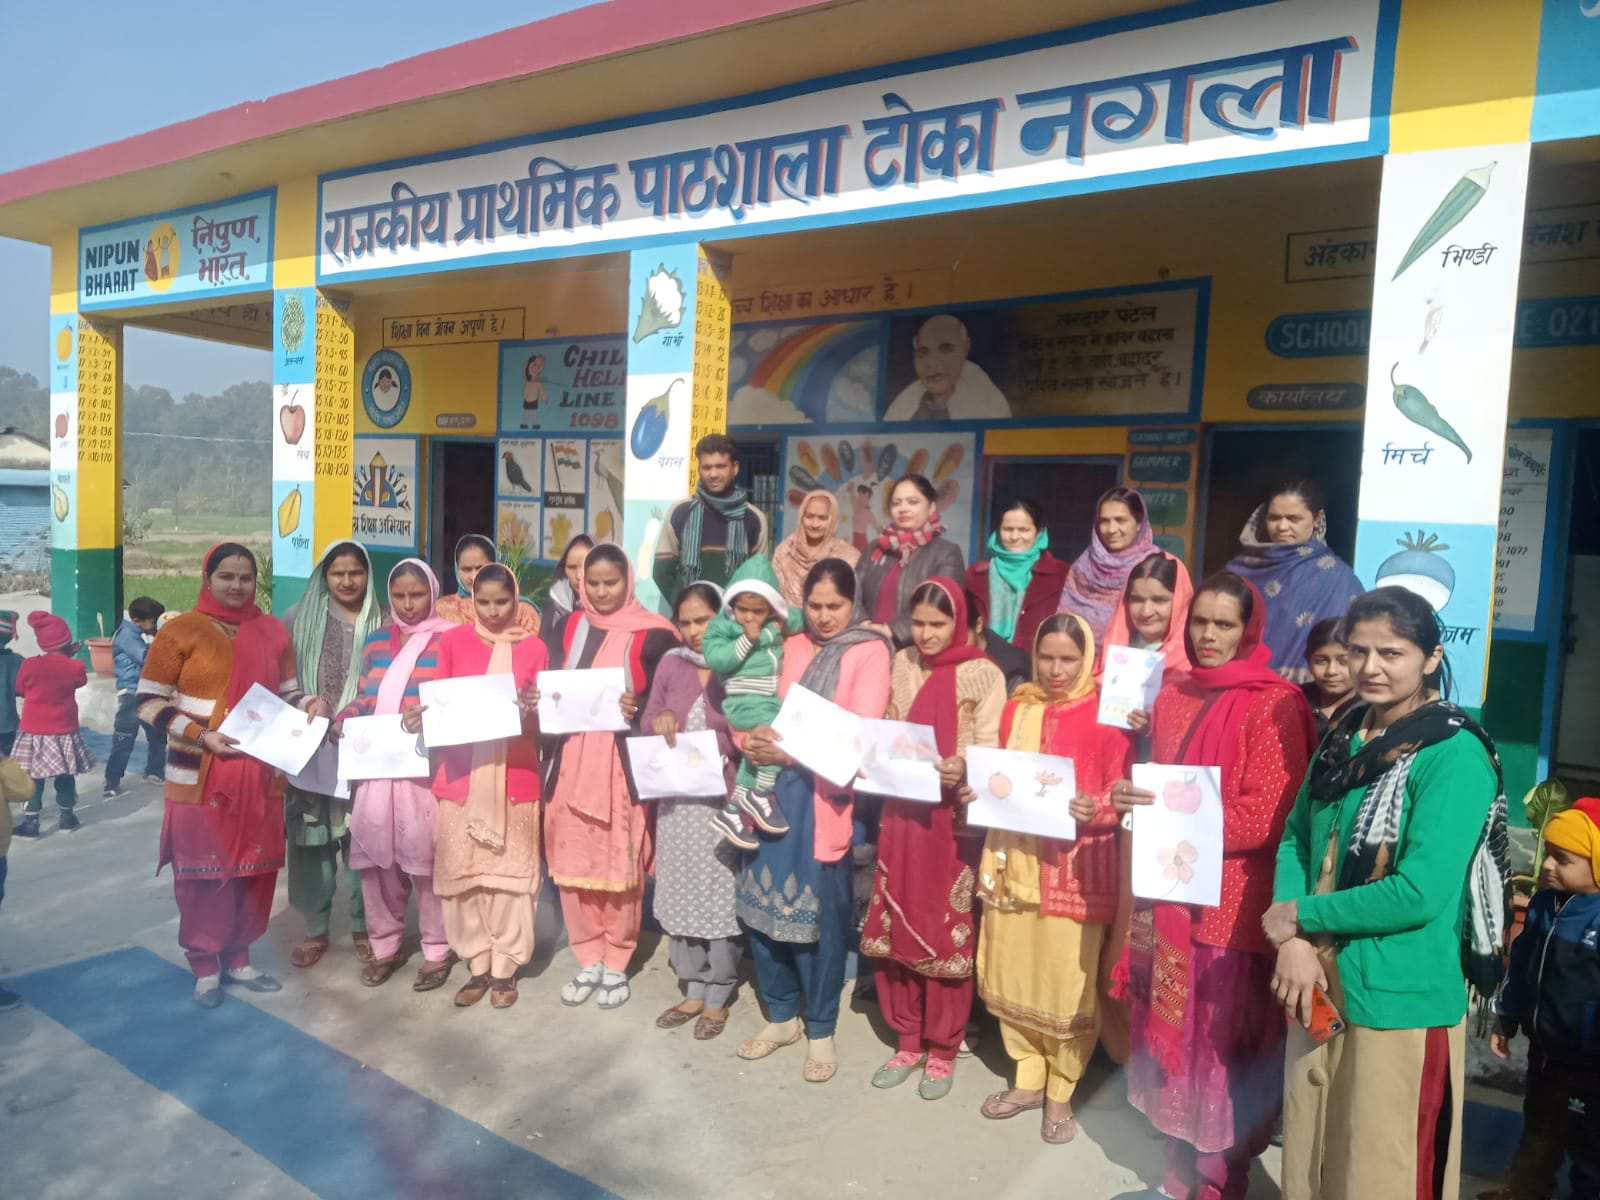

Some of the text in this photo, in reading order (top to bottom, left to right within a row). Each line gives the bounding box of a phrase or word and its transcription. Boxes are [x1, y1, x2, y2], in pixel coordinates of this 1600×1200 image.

[324, 36, 1359, 266] राजकीय प्राथमिक पाठशाला टोका नगला
[191, 215, 261, 253] निपुण
[85, 239, 140, 270] NIPUN
[85, 268, 139, 296] BHARAT
[198, 252, 250, 286] भारत
[564, 344, 625, 368] CHIL
[560, 391, 615, 408] LINE
[569, 411, 619, 429] 1098
[1381, 441, 1434, 465] मिर्च
